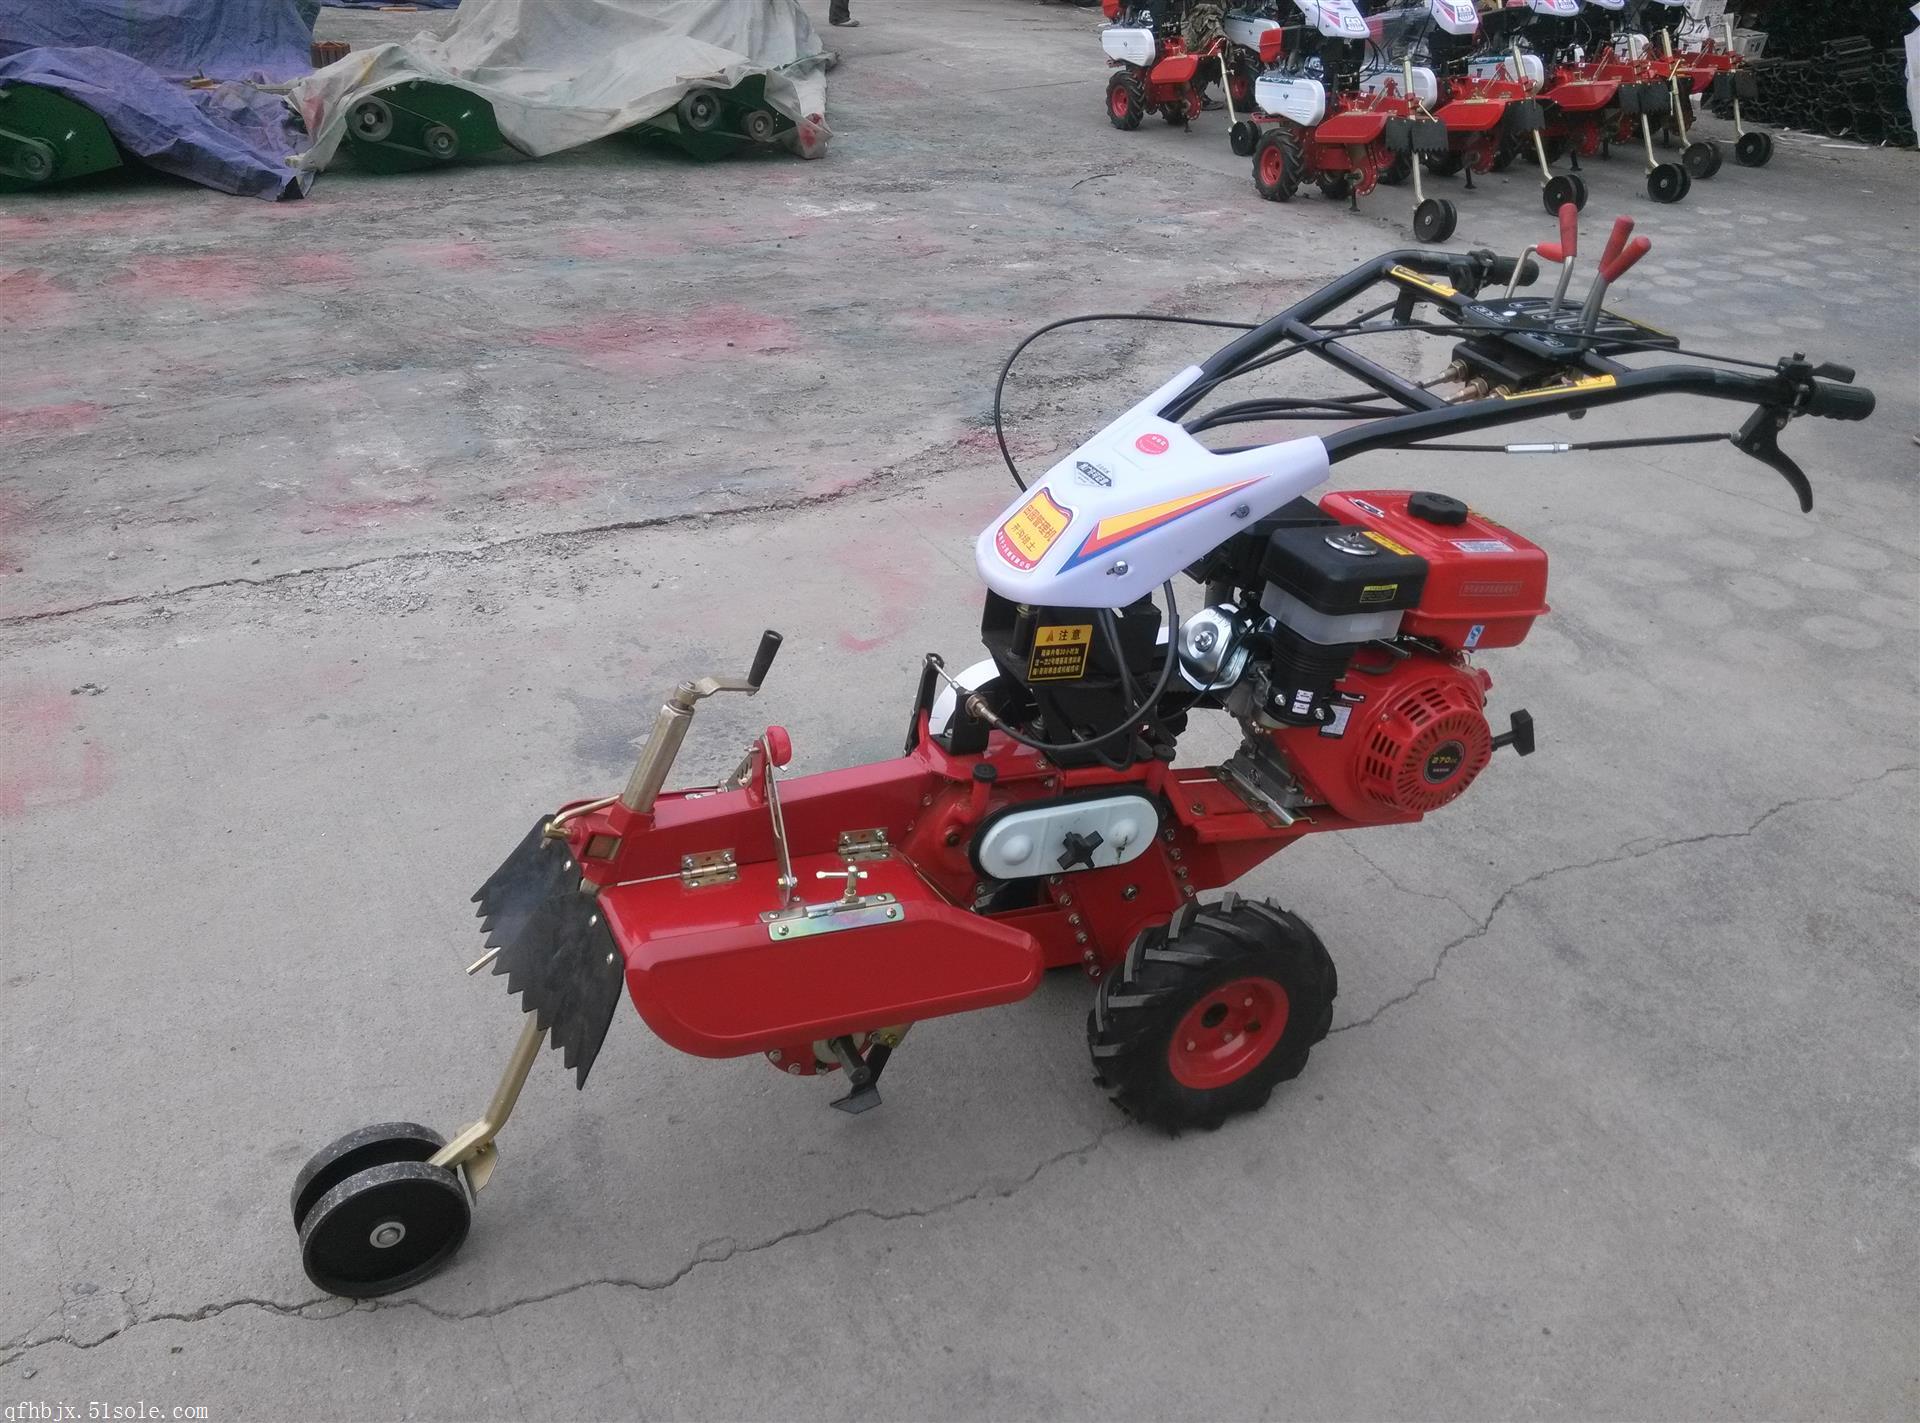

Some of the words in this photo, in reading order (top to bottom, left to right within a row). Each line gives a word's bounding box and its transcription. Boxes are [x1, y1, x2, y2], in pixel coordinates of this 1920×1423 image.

[1023, 504, 1057, 542] 田园管理机
[1058, 628, 1081, 641] 注意
